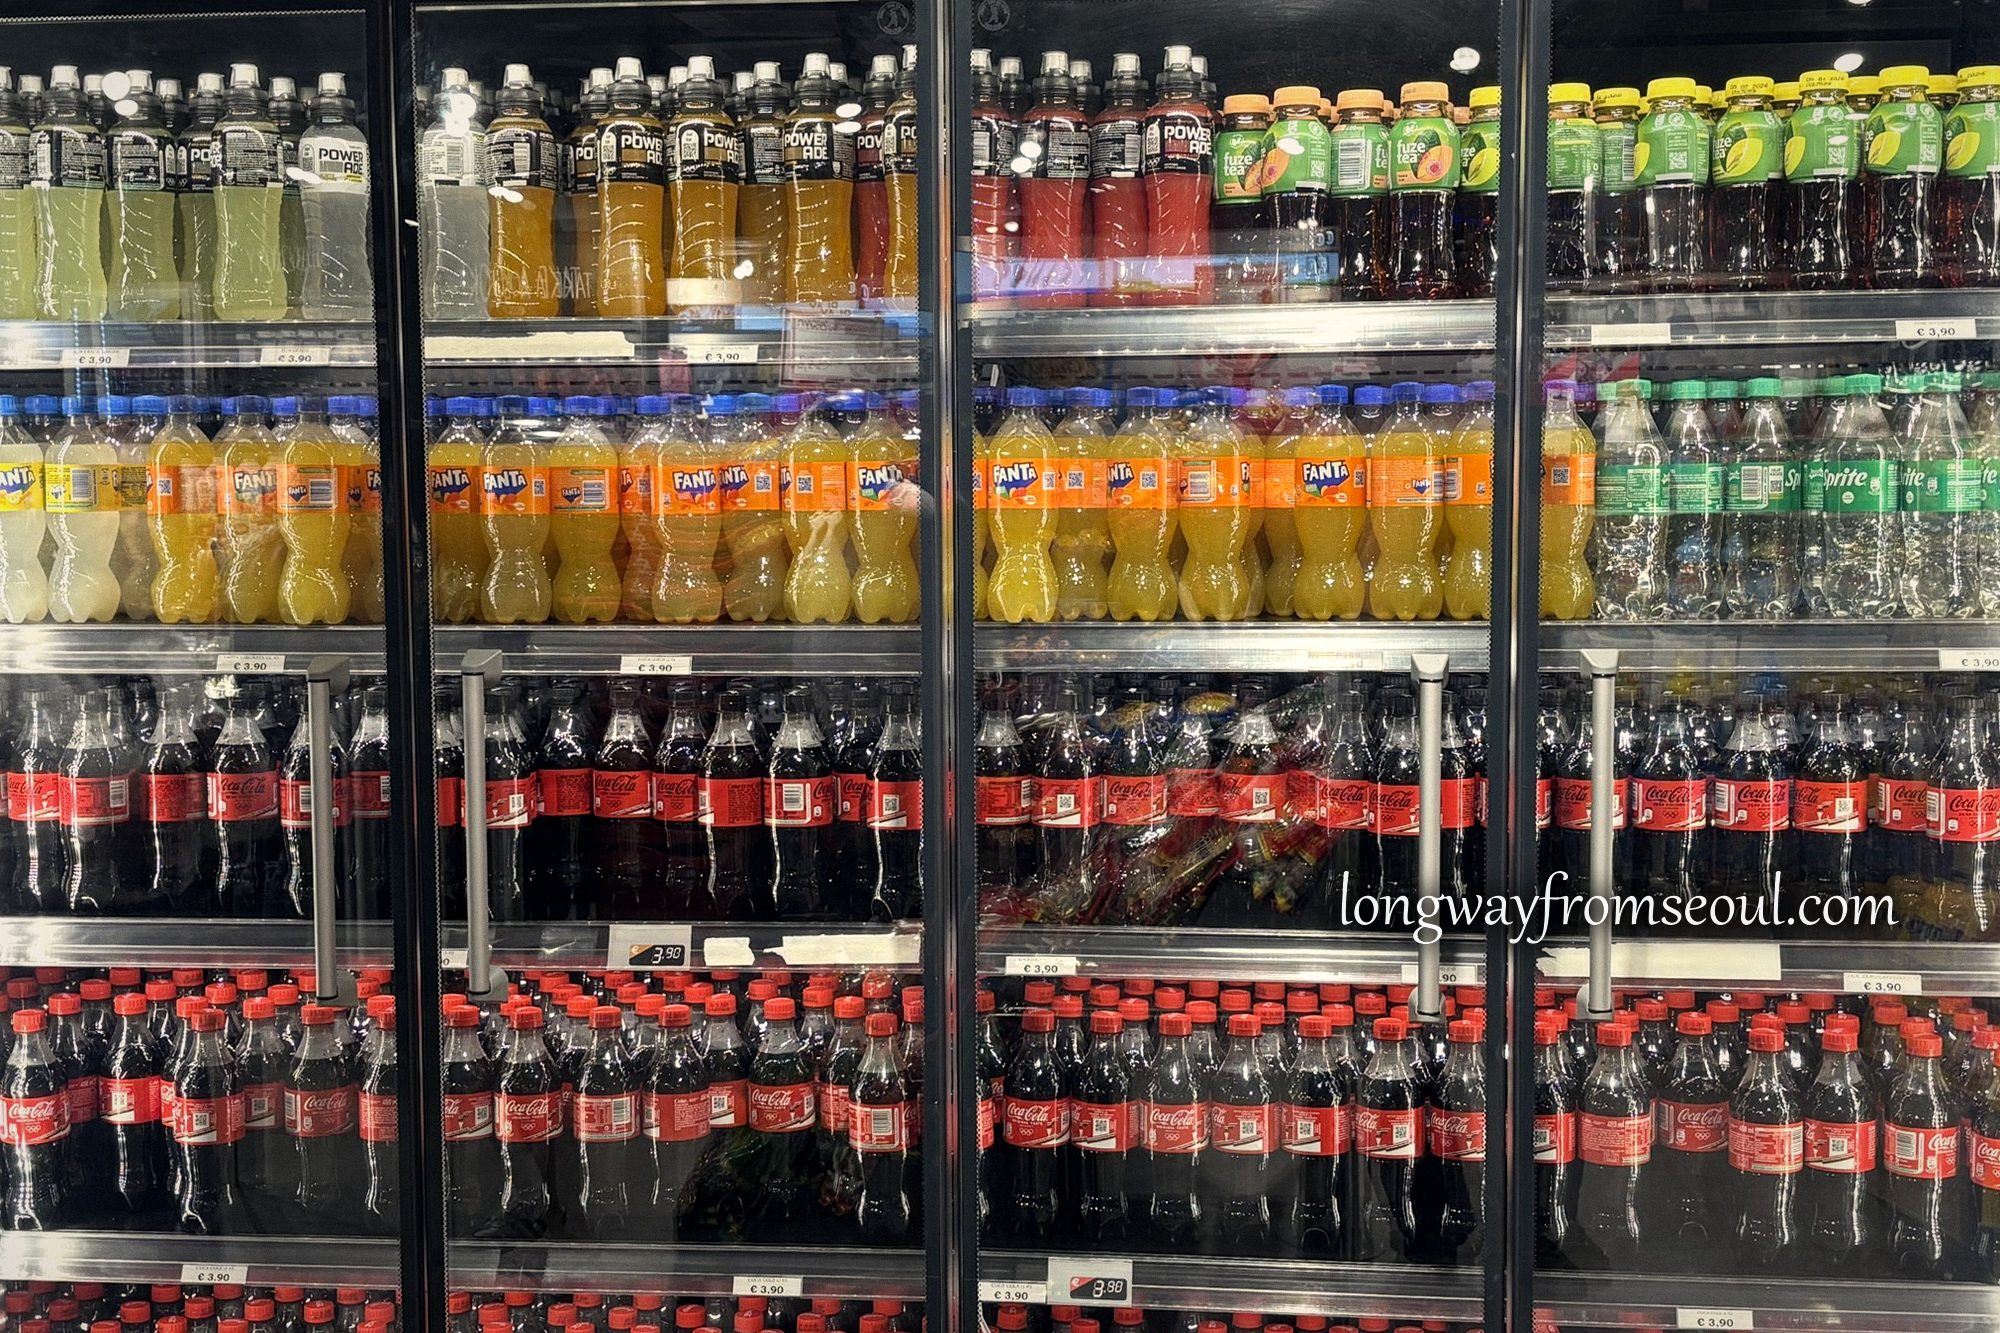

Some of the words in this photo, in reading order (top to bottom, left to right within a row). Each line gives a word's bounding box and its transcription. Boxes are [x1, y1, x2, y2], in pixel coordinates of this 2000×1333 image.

[784, 132, 828, 148] POWER
[1164, 126, 1212, 142] POWER
[319, 148, 364, 162] POWER
[802, 146, 828, 160] ADE
[1189, 140, 1212, 155] ADE
[1396, 140, 1426, 155] fuze
[1223, 152, 1253, 168] fuze
[1396, 150, 1419, 165] tea
[344, 162, 364, 174] ADE
[1223, 163, 1246, 177] tea
[1917, 328, 1925, 336] €
[79, 356, 86, 364] €
[705, 353, 713, 361] €
[993, 463, 1037, 483] FANTA
[1302, 462, 1349, 481] FANTA
[484, 470, 527, 489] FANTA
[234, 662, 241, 670] €
[638, 664, 645, 672] €
[1961, 658, 1968, 666] €
[1646, 785, 1694, 803] Coca-Cola
[1738, 784, 1786, 803] Coca-Cola
[1023, 964, 1031, 973] €
[1864, 982, 1871, 990] €
[304, 1091, 349, 1111] Coca-Cola
[751, 1088, 794, 1106] Coca-Cola
[8, 1100, 56, 1119] Coca-Cola
[506, 1098, 551, 1116] Coca-Cola
[1007, 1102, 1053, 1122] Coca-Cola
[1150, 1107, 1196, 1126] Coca-Cola
[1677, 1107, 1723, 1125] Coca-Cola
[197, 1272, 205, 1281] €
[750, 1285, 757, 1293] €
[994, 1291, 1001, 1299] €
[1697, 1318, 1705, 1327] €
